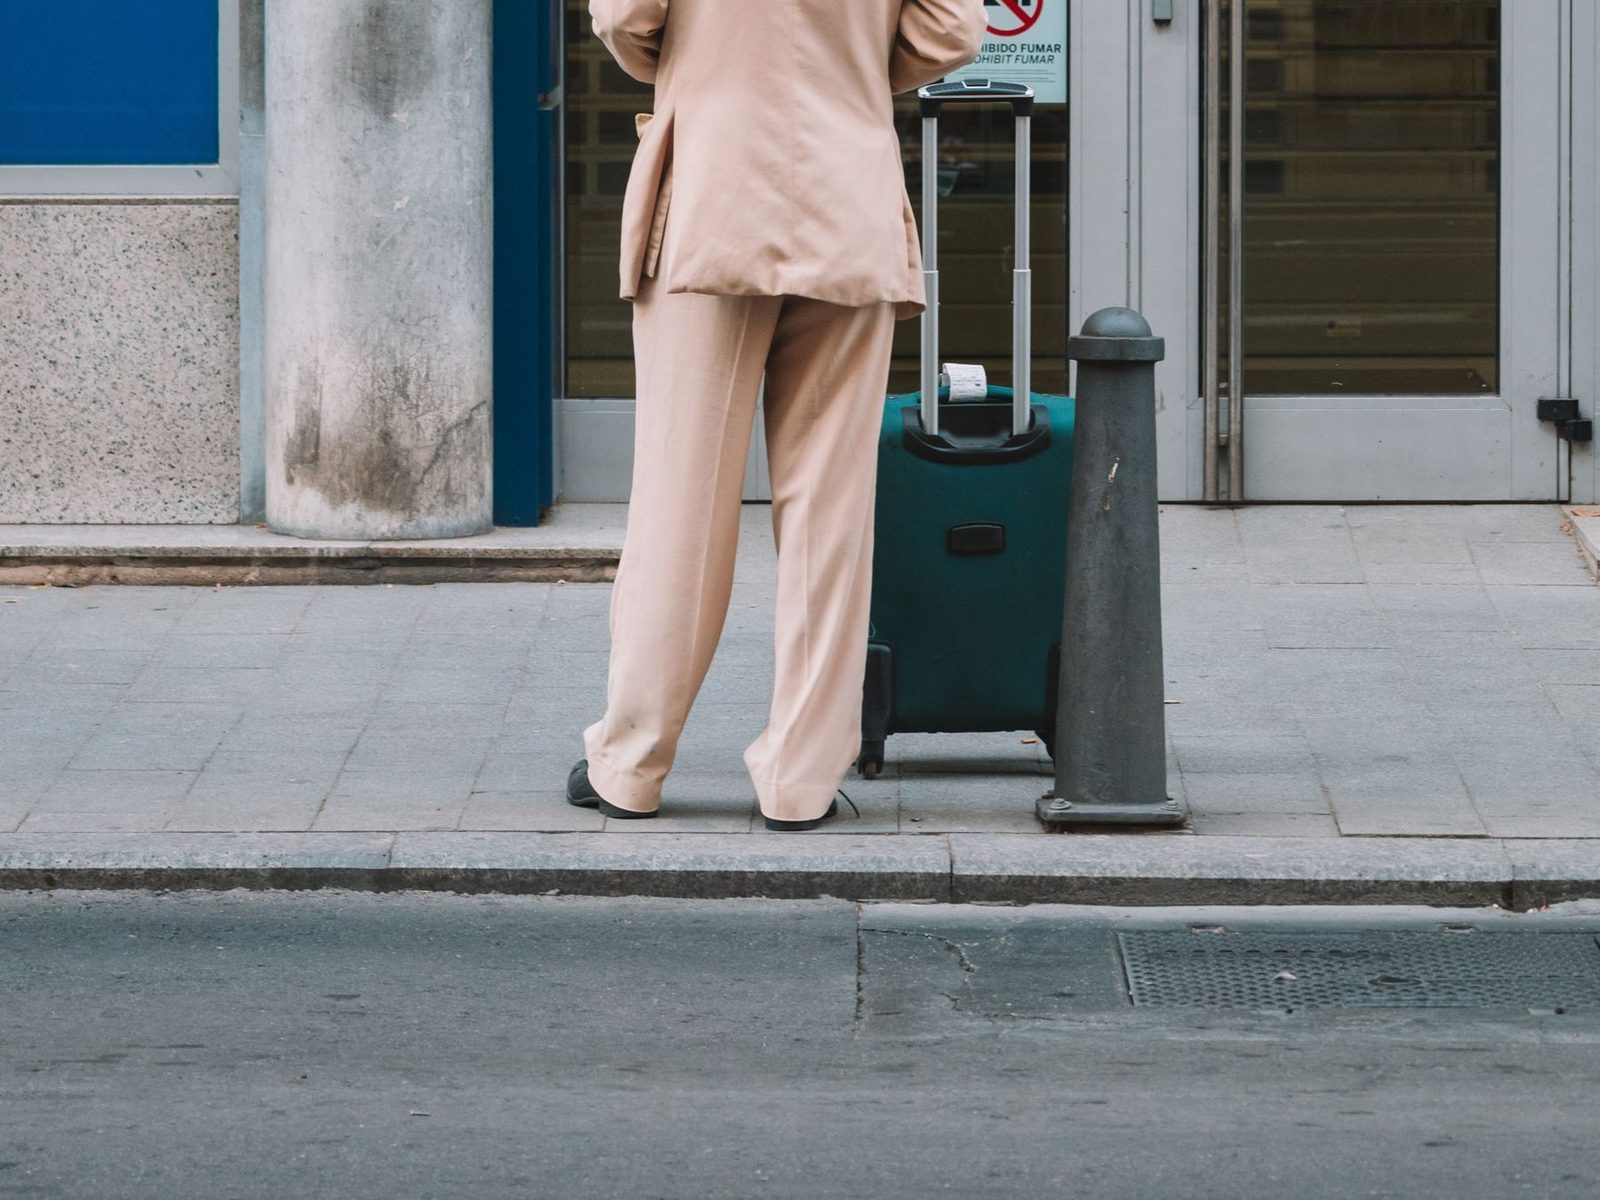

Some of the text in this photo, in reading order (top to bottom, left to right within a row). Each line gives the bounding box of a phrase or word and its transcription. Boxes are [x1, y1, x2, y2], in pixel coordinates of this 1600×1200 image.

[981, 43, 1061, 53] IBIDO FUMAR
[974, 54, 1055, 64] OHIBIT FUMAR
